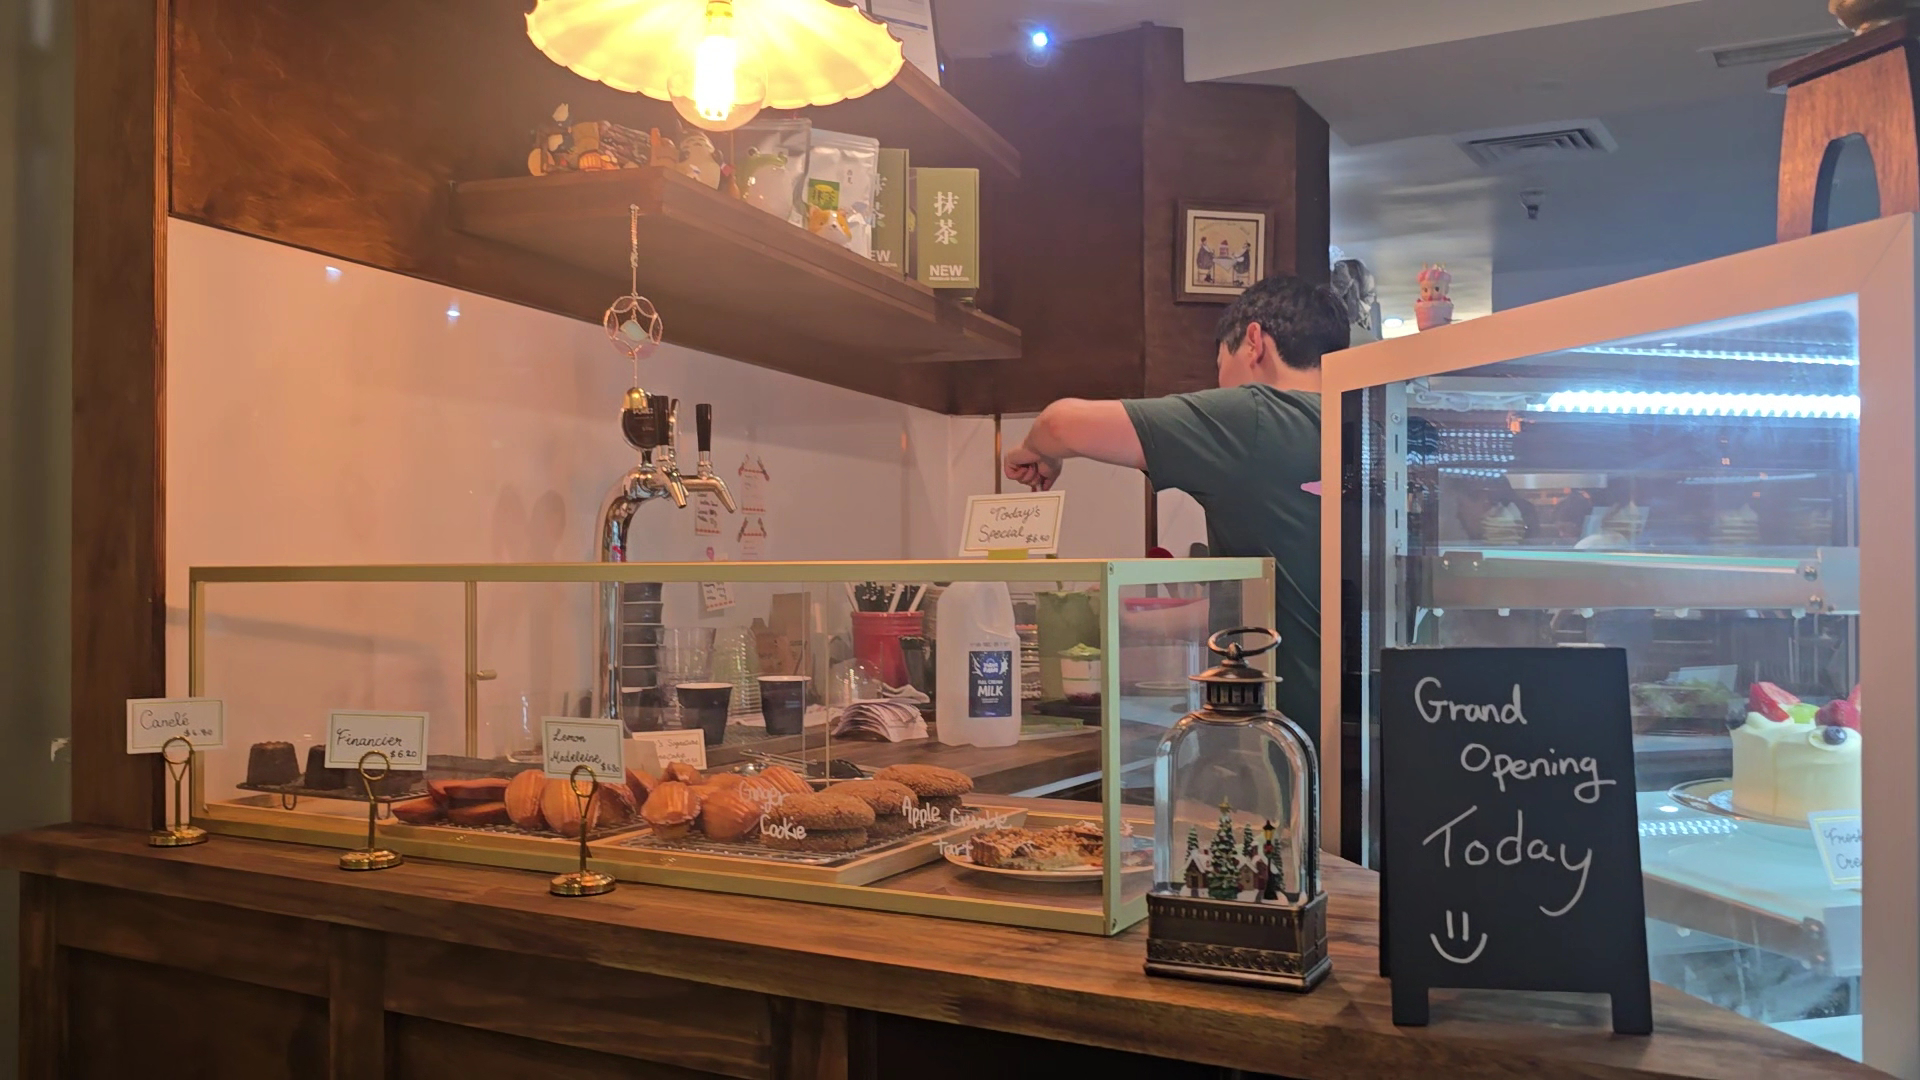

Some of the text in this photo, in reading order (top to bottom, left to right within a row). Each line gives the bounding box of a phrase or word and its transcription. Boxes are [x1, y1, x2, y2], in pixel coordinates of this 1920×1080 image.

[933, 191, 960, 245] 抹茶
[870, 250, 891, 262] EW
[929, 264, 963, 277] NEW
[990, 505, 1041, 524] Today's
[978, 525, 1025, 543] Special
[977, 685, 1004, 697] MILK
[1414, 676, 1528, 725] Grand
[336, 728, 417, 759] Financier $6.20
[553, 728, 586, 743] Lemon
[1460, 743, 1617, 803] Opening
[738, 781, 791, 813] Ginger
[901, 796, 1013, 831] Apple Crumble
[759, 814, 807, 840] Cookie
[1422, 805, 1593, 917] Today
[1836, 853, 1862, 870] Cre
